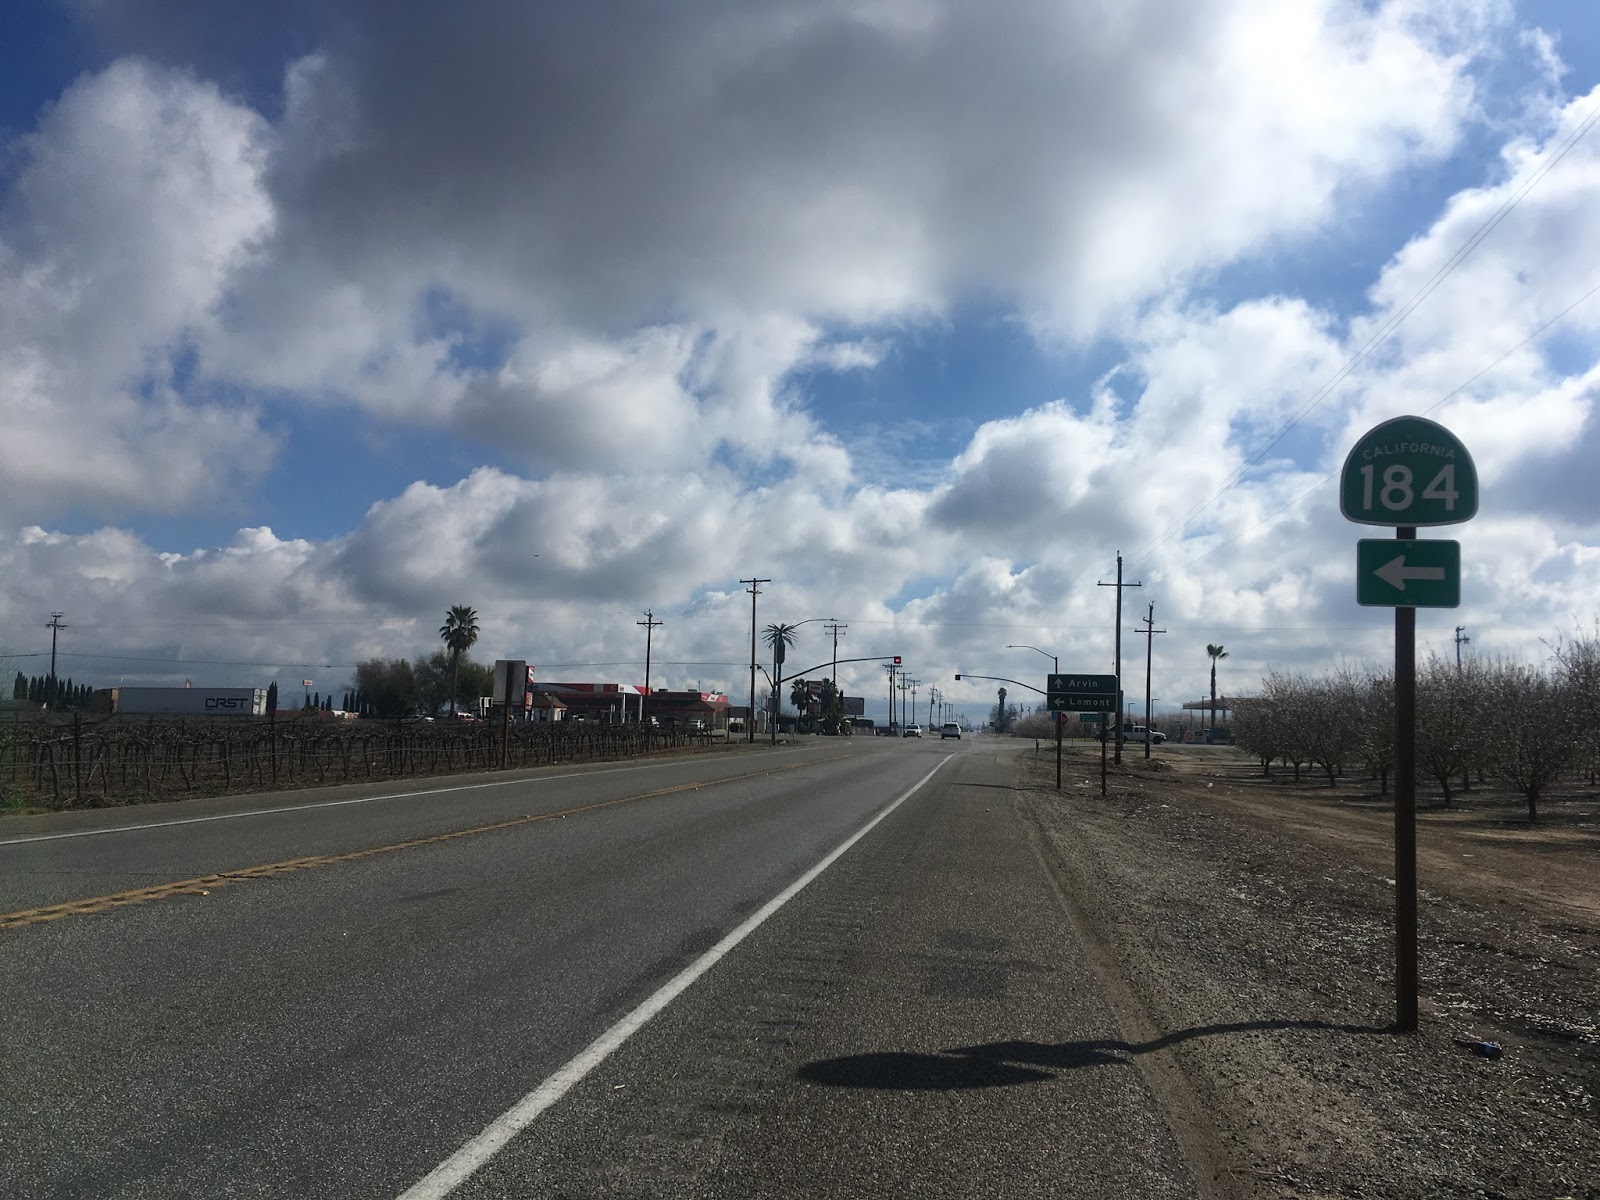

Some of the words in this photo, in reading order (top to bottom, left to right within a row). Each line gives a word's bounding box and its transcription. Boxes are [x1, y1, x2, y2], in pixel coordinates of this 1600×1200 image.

[1363, 443, 1455, 460] CALIFORNIA
[1360, 464, 1459, 511] 184
[1069, 680, 1098, 688] Arvin
[205, 698, 248, 708] CRST
[1069, 697, 1110, 706] Lamont
